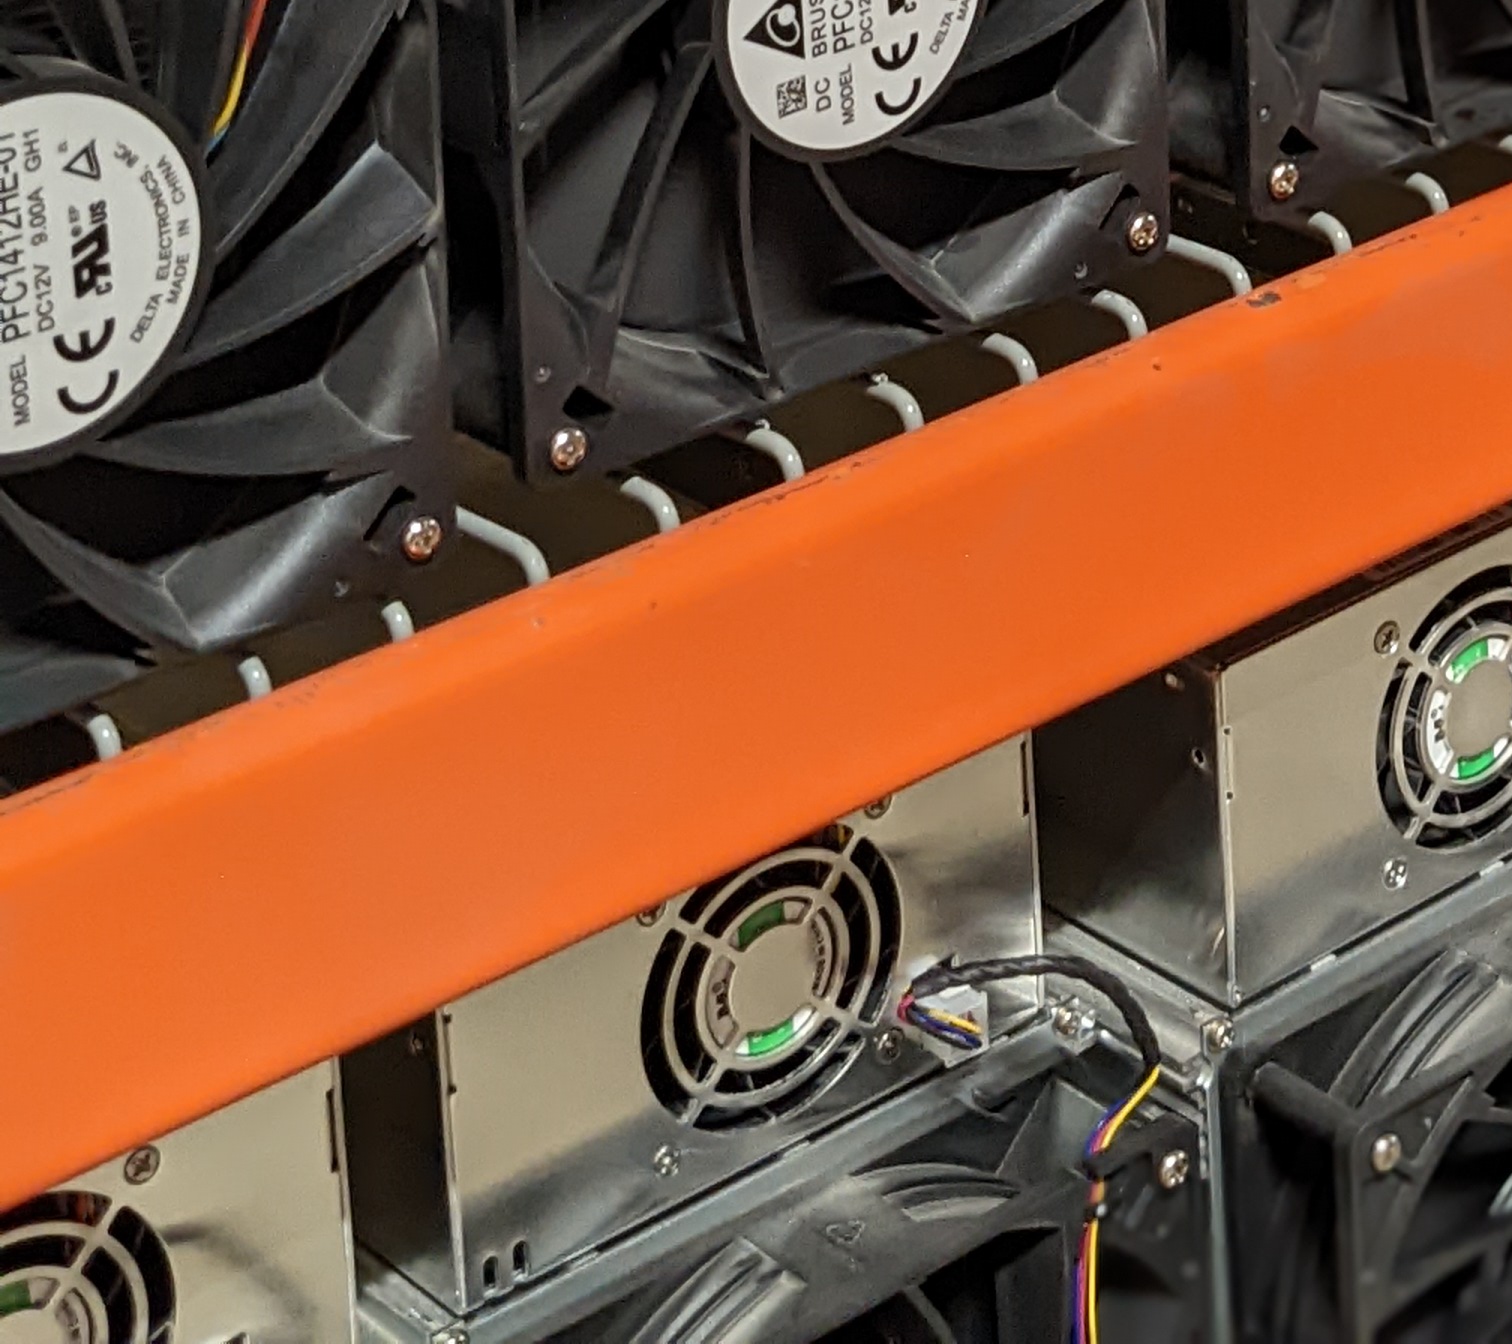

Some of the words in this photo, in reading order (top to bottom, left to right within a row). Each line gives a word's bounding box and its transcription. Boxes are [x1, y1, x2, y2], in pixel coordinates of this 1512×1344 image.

[929, 11, 955, 55] DELTA
[814, 77, 832, 112] DC
[839, 63, 855, 125] MODEL
[22, 128, 41, 173] GH1
[112, 141, 139, 168] INC.
[157, 155, 185, 204] CHINA
[0, 132, 31, 343] PFC1412HE-01
[30, 187, 48, 247] 9.00A
[177, 220, 190, 237] IN
[33, 264, 55, 332] DC12V
[166, 254, 190, 305] MADE
[129, 293, 164, 344] DELTA
[9, 355, 30, 426] MODEL
